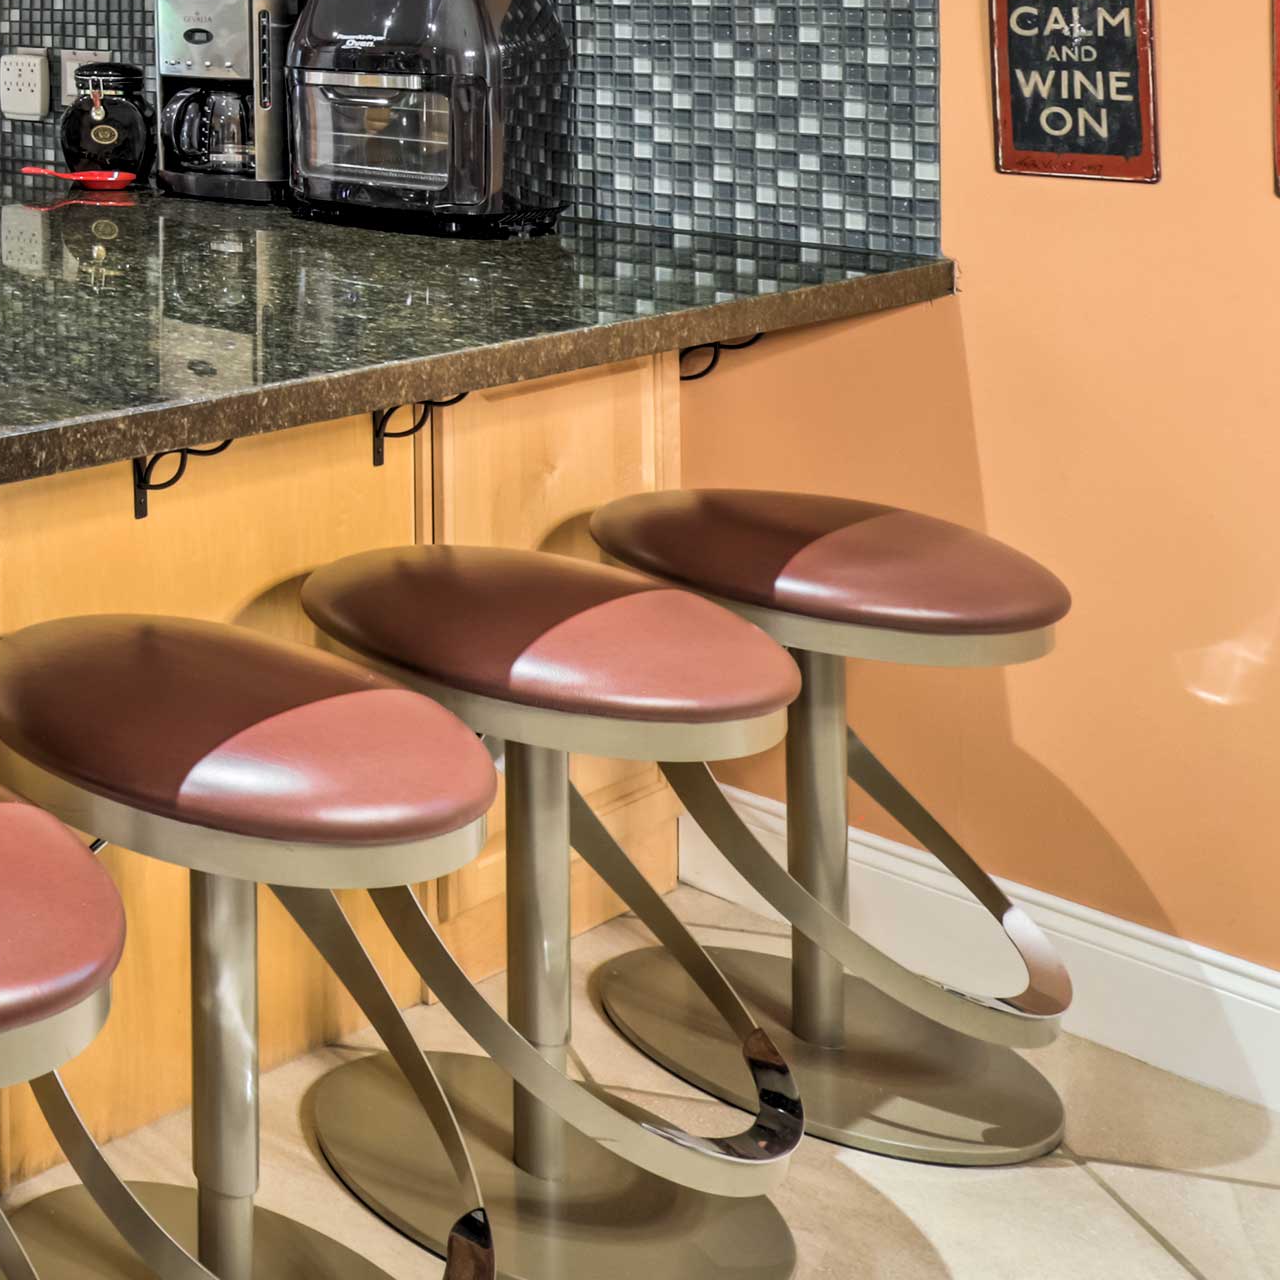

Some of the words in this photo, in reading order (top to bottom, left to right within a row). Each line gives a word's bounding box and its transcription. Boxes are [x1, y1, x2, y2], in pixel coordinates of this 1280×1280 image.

[1009, 6, 1132, 38] CALM
[1045, 45, 1098, 62] AND
[1014, 68, 1134, 102] WINE
[1039, 106, 1110, 139] ON
